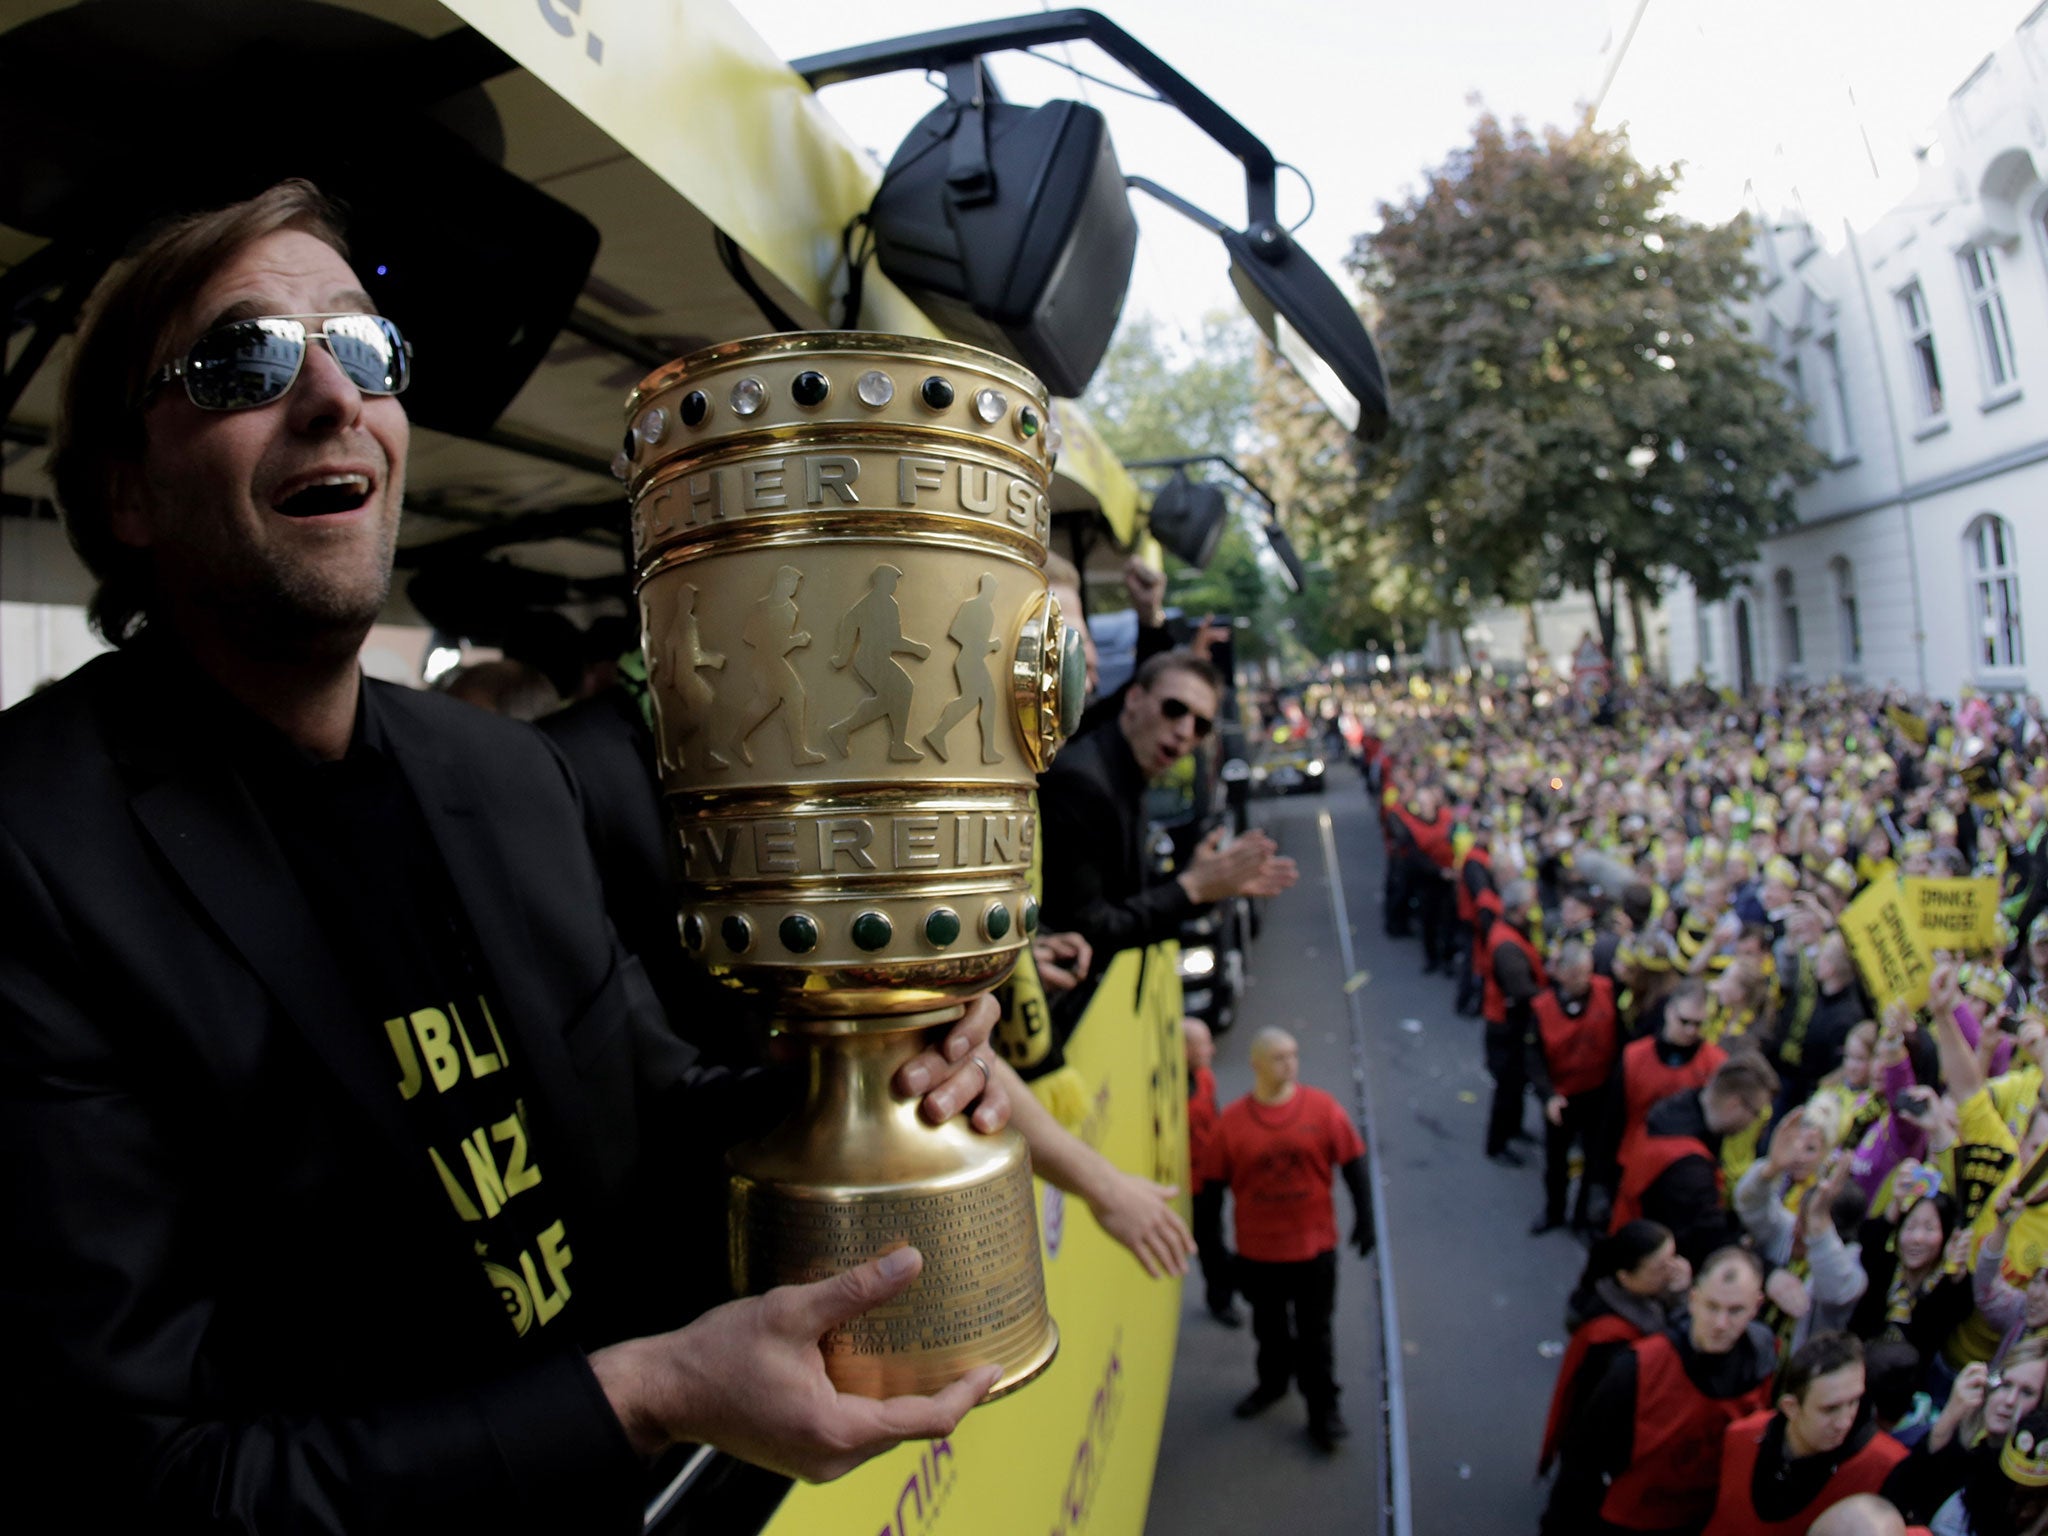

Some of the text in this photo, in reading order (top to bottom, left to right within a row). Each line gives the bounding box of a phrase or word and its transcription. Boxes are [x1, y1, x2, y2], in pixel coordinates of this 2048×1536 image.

[921, 1243, 971, 1261] AYERN
[852, 1344, 885, 1356] 2010
[921, 1328, 983, 1351] BAYERN
